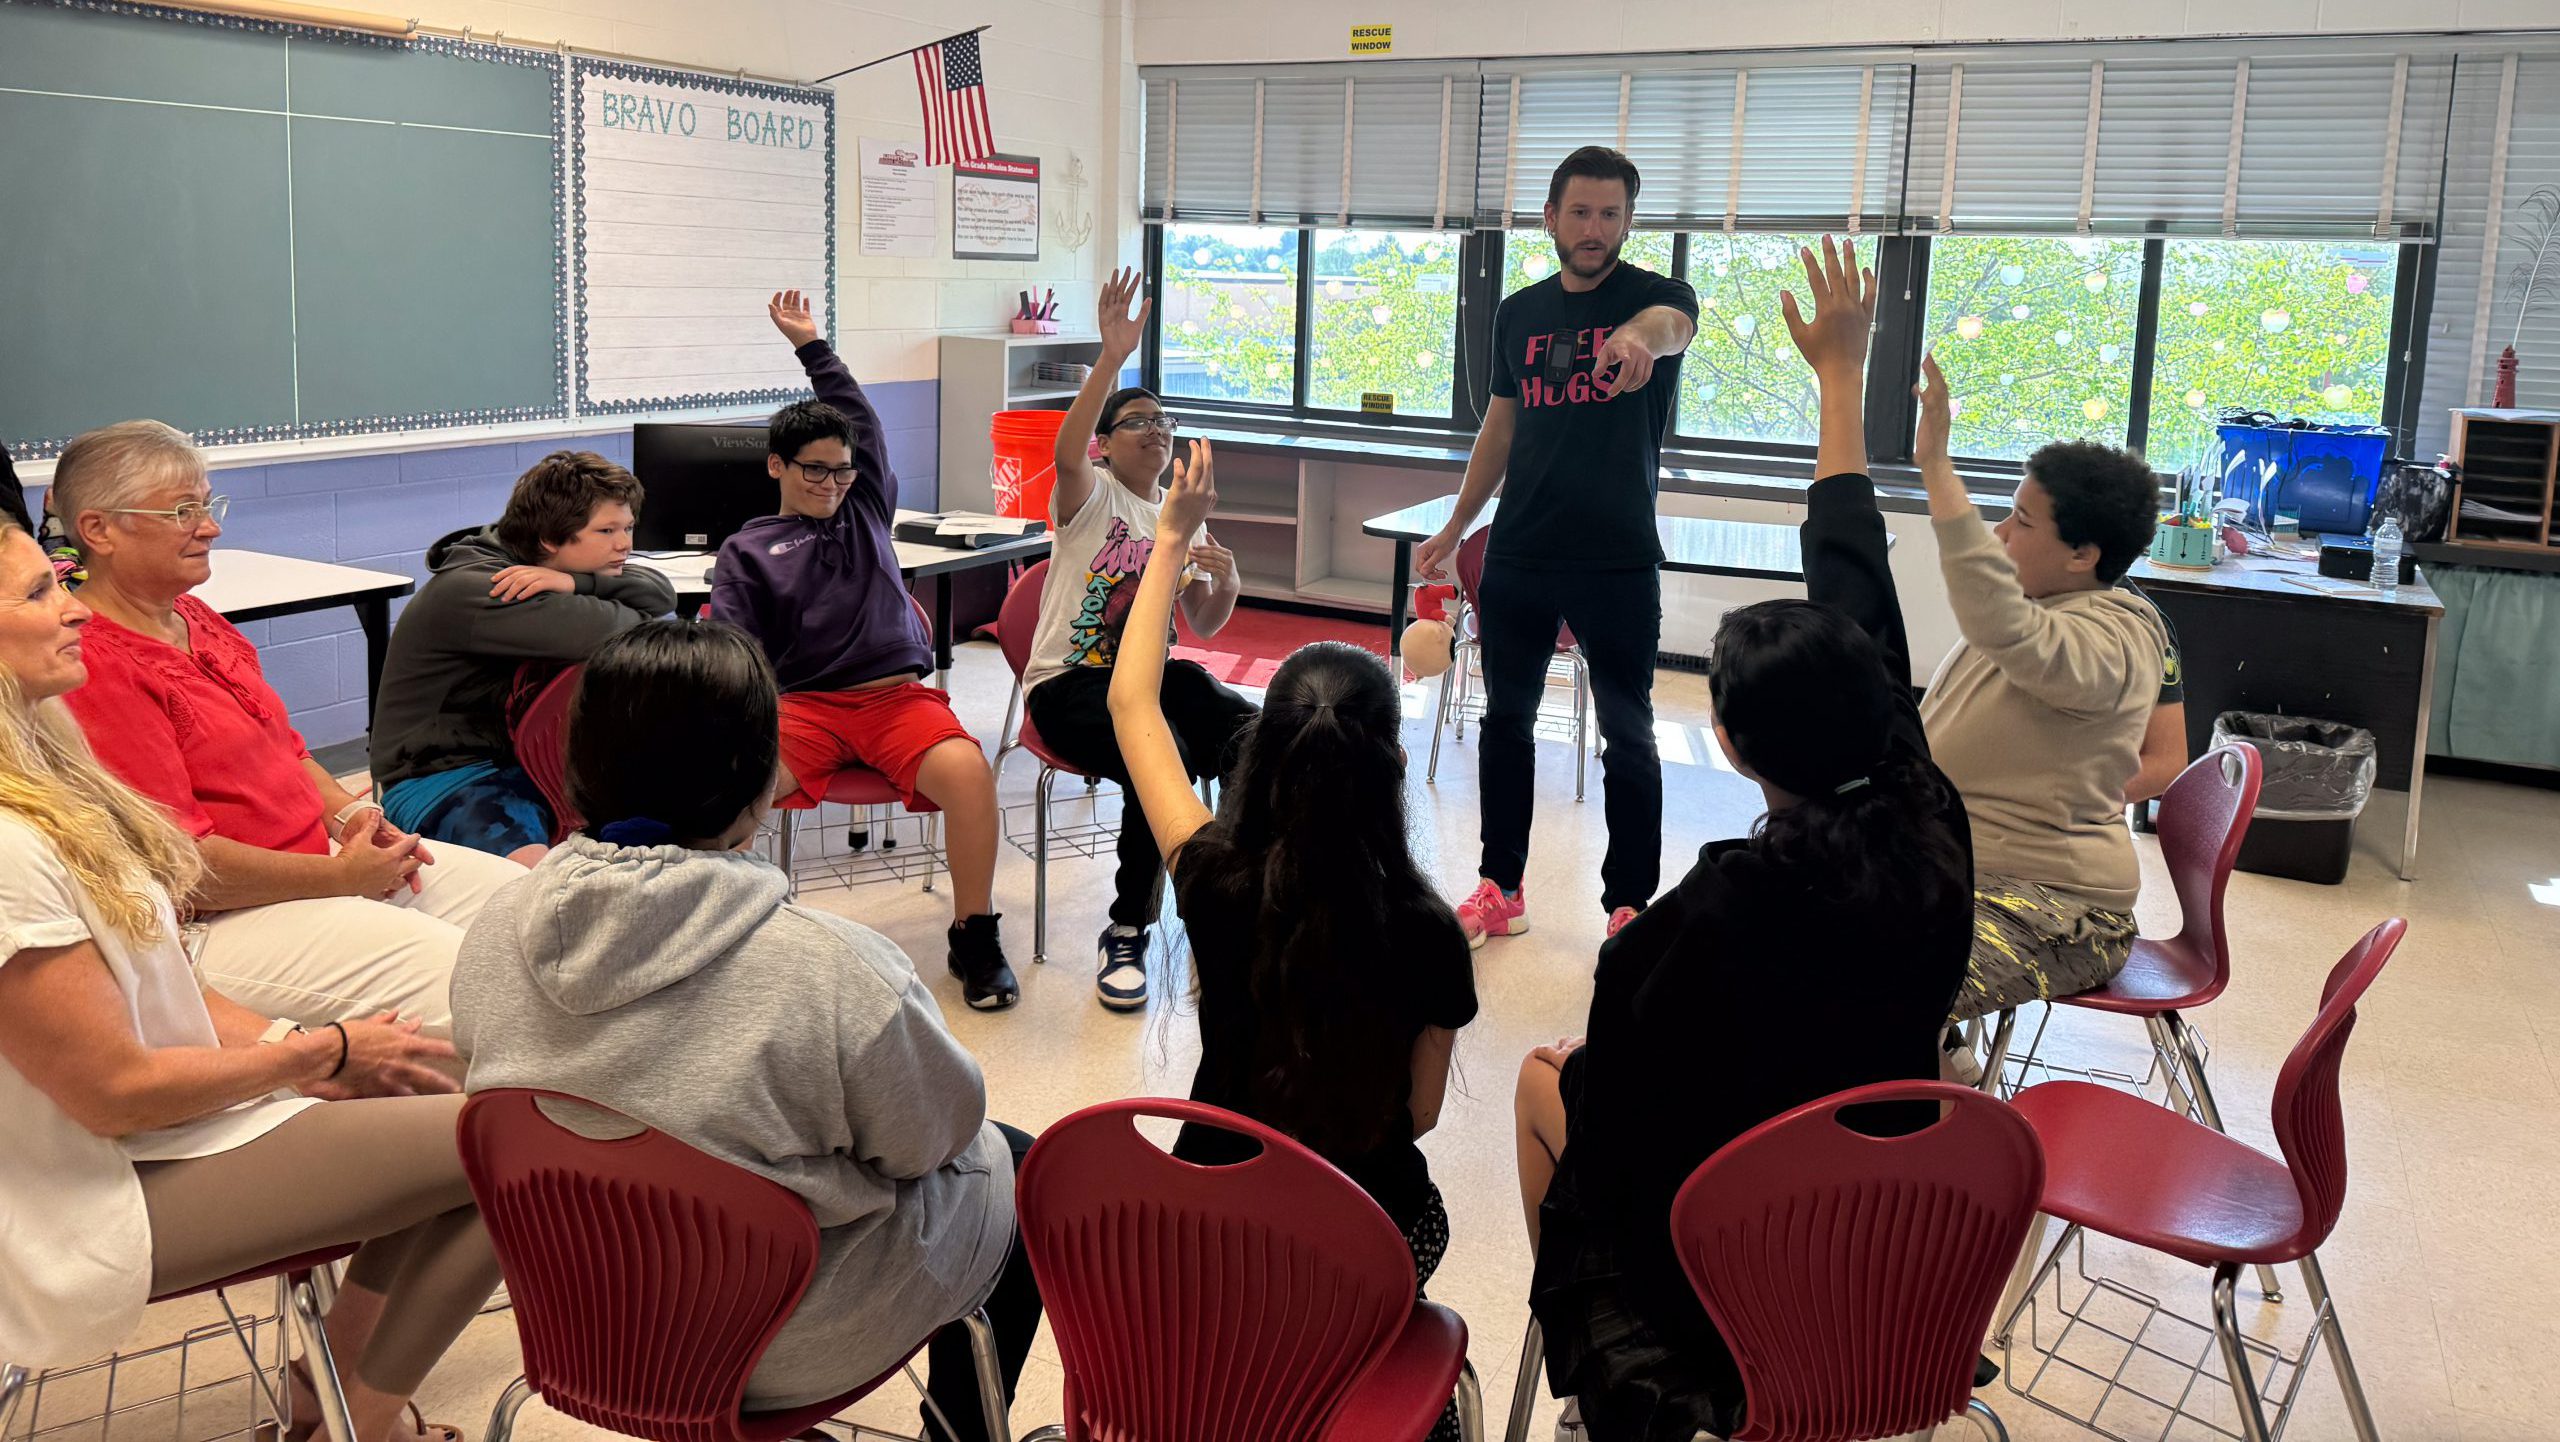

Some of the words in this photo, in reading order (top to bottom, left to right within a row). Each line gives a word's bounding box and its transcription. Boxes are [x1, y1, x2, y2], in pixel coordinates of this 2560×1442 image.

[1352, 28, 1391, 37] RESCUE
[1351, 42, 1391, 50] WINDOW
[603, 89, 697, 136] BRAVO
[727, 105, 814, 150] BOARD
[970, 161, 986, 170] Grade
[987, 162, 1007, 172] Mission
[1007, 165, 1034, 175] Statement
[1520, 370, 1615, 409] HUGS
[1361, 402, 1392, 410] WINDOW
